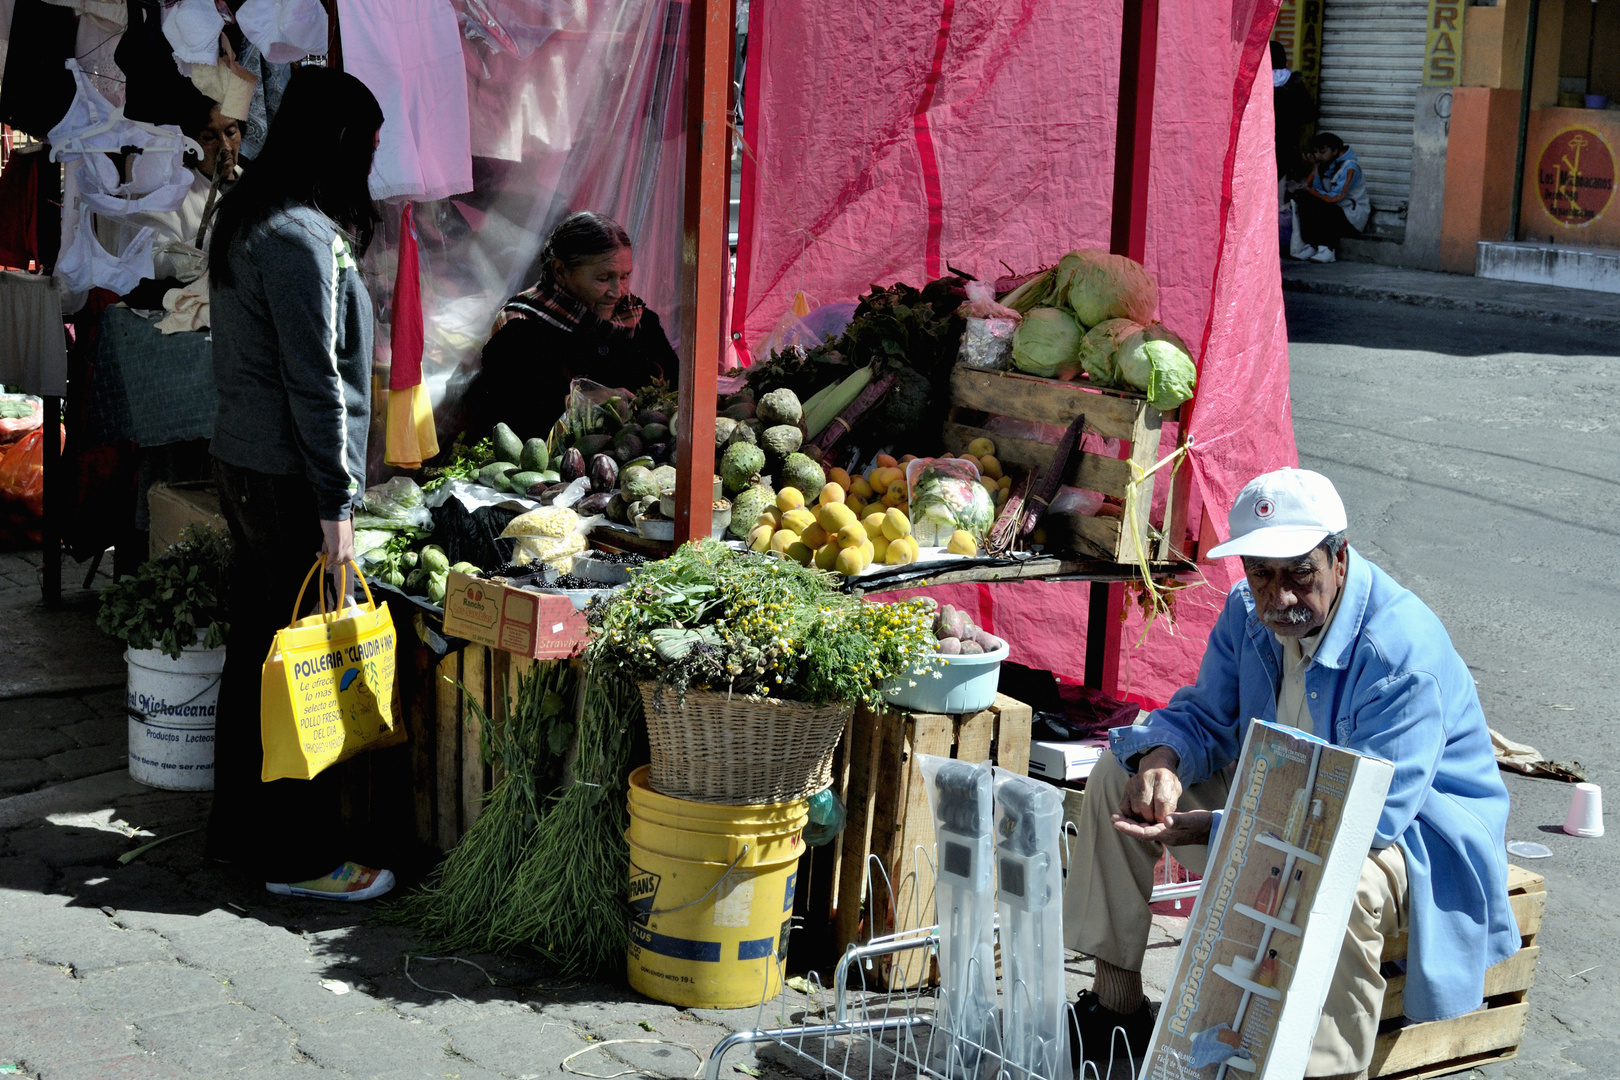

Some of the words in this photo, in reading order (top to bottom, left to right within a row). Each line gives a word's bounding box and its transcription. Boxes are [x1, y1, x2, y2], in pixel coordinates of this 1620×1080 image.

[294, 651, 344, 680] POLLERIA
[300, 682, 310, 692] Le
[312, 677, 335, 689] ofrece
[304, 691, 313, 702] lo
[303, 701, 327, 715] selecto
[328, 699, 337, 708] en
[300, 714, 322, 730] POLLO
[321, 708, 344, 725] FRESCO
[146, 728, 180, 743] Productos
[185, 733, 215, 743] Lacteos
[313, 728, 326, 741] DEL
[160, 761, 177, 771] que
[178, 763, 195, 771] ser
[1170, 966, 1204, 1034] Repisa
[1194, 866, 1238, 961] Esquinero
[1231, 814, 1253, 865] para
[1242, 758, 1267, 811] Baño
[631, 925, 653, 943] PLUS
[665, 974, 680, 982] NETO
[680, 976, 689, 984] 19
